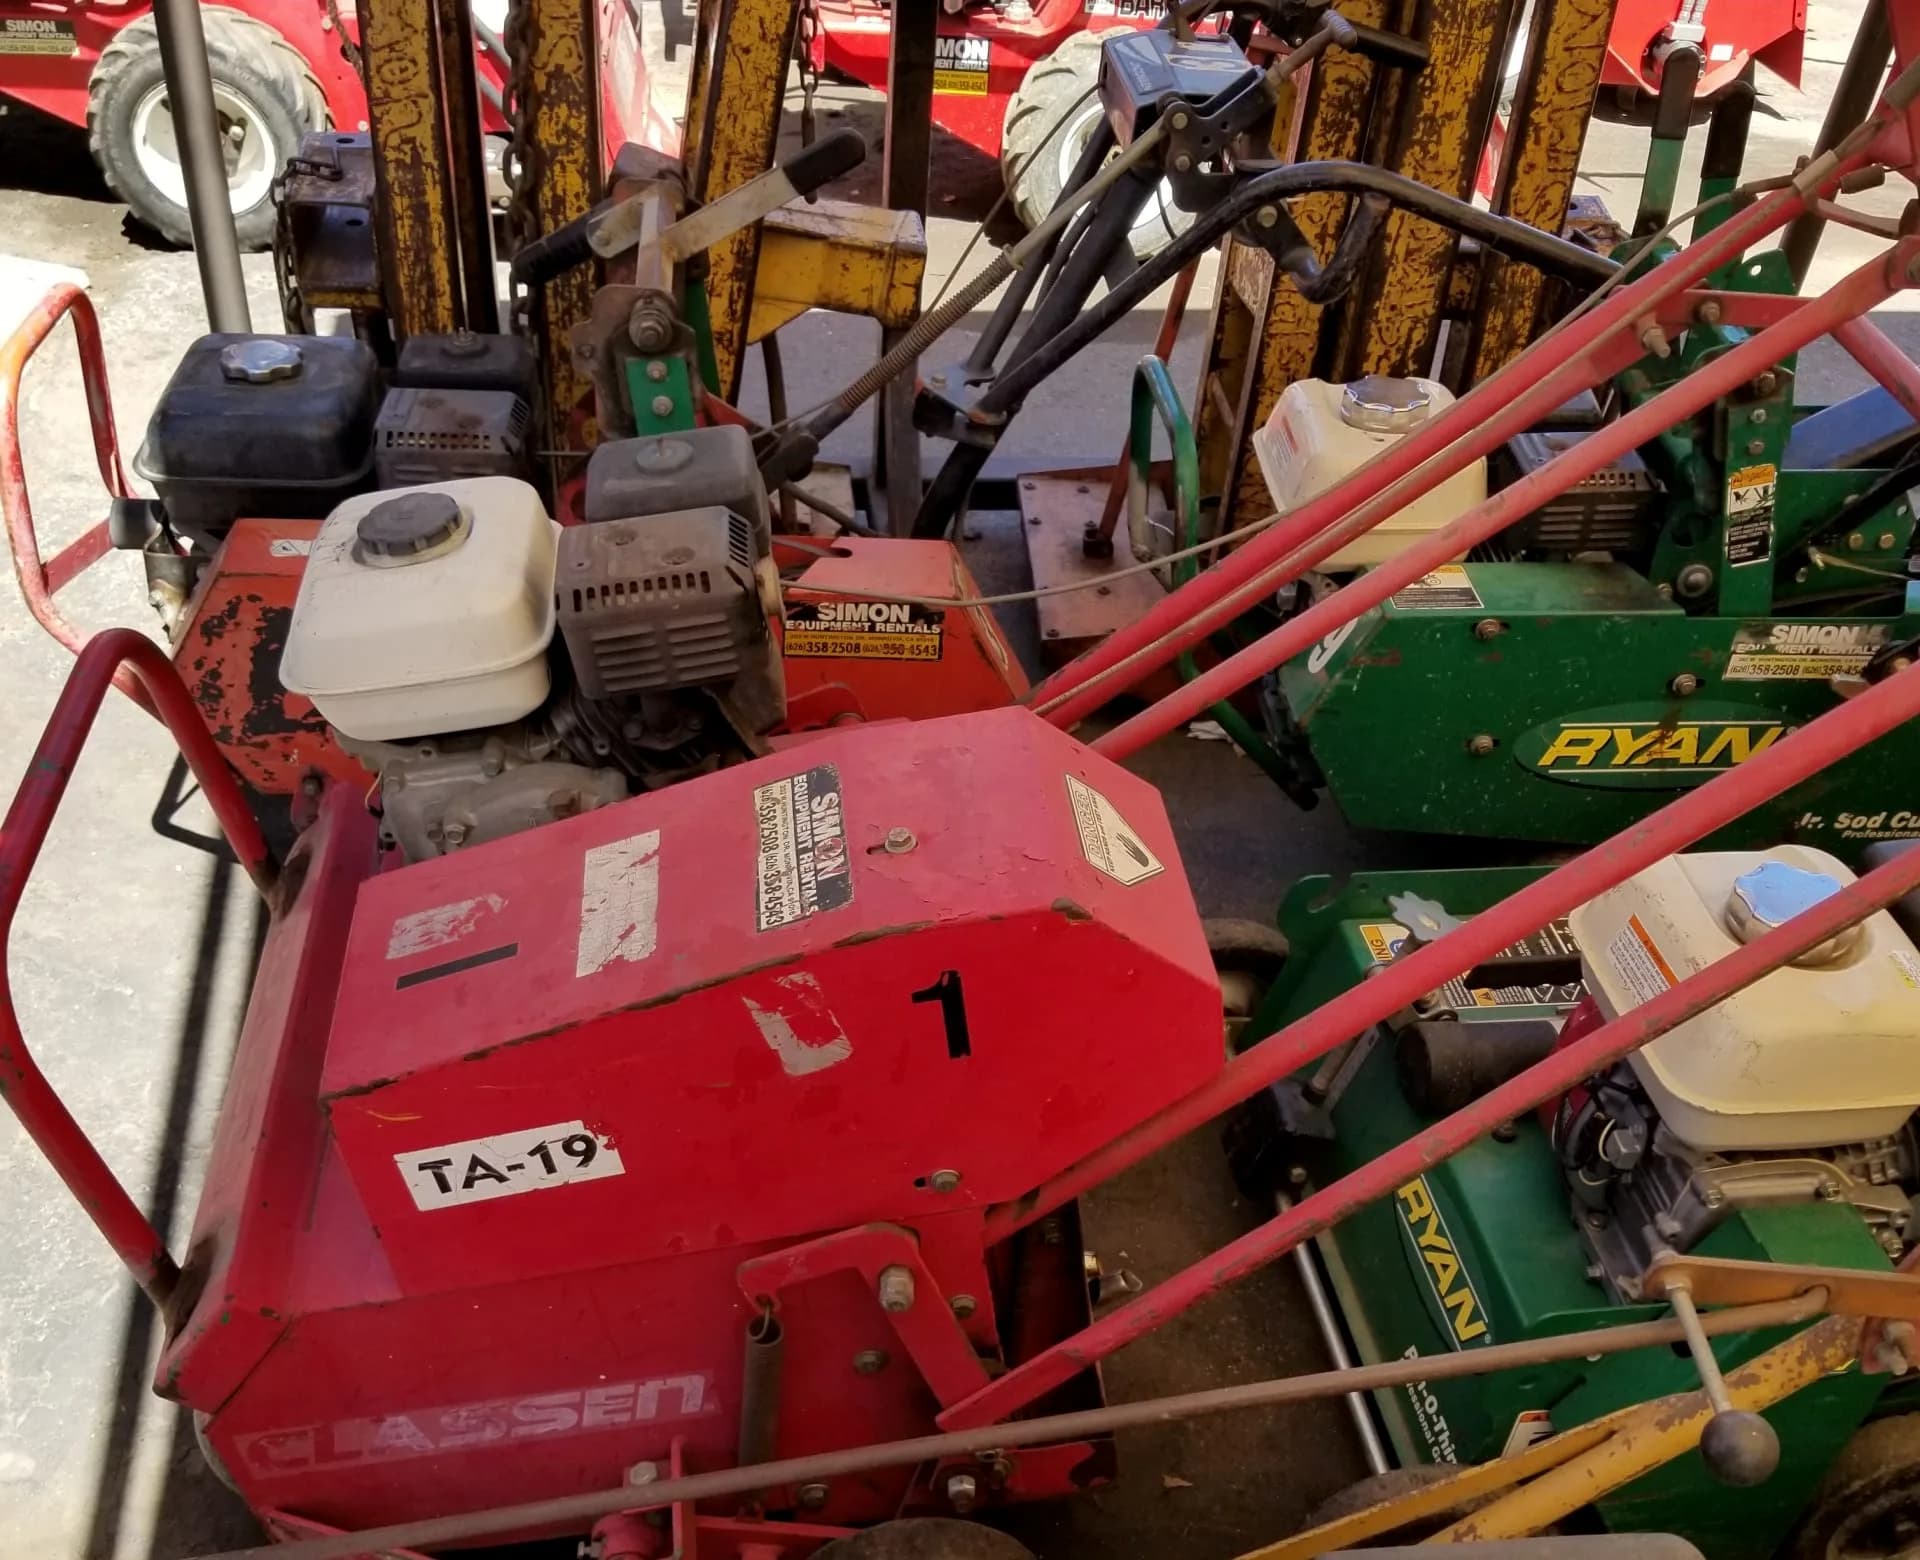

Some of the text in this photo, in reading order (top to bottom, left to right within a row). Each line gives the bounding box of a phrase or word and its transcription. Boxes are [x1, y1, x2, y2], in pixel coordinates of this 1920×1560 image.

[5, 19, 57, 33] SIMON
[935, 38, 989, 60] MON
[784, 619, 941, 634] EQUIPMENT RENTALS
[817, 602, 911, 623] SIMON
[1768, 624, 1861, 645] SIMON
[1537, 726, 1786, 768] RYAN
[1075, 790, 1104, 860] DANGER
[1833, 811, 1888, 829] Sod
[1841, 828, 1920, 839] Professiona
[794, 774, 820, 916] EQUIPMENT RENTALS
[811, 792, 848, 881] SIMON
[911, 969, 972, 1060] 1
[418, 1133, 598, 1194] TA-19
[1397, 1178, 1488, 1343] RYAN
